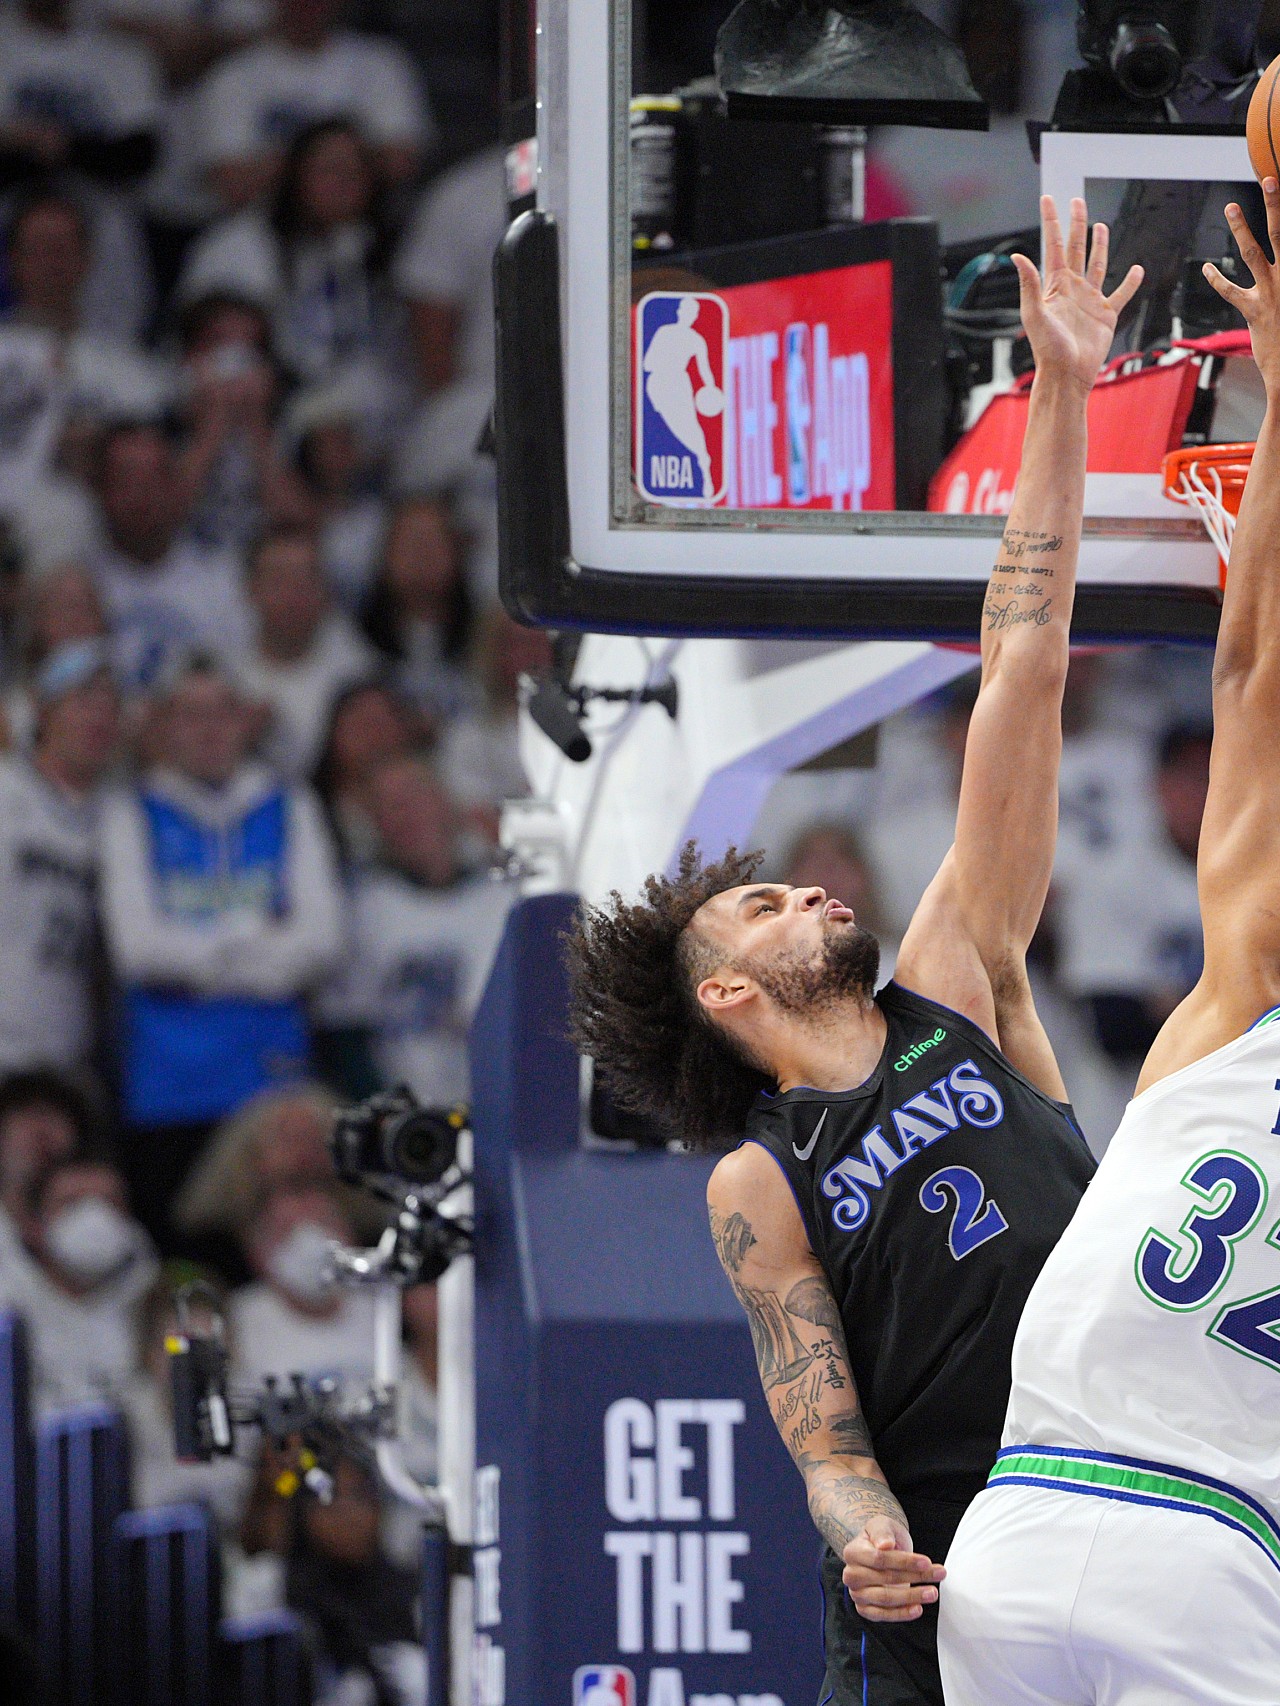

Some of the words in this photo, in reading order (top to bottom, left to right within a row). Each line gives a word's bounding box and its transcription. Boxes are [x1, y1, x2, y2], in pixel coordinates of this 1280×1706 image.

[651, 455, 694, 489] NBA
[893, 1027, 946, 1072] chime
[821, 1058, 1004, 1232] MAVS
[919, 1165, 1009, 1261] 2
[604, 1397, 746, 1522] GET
[604, 1531, 752, 1653] THE
